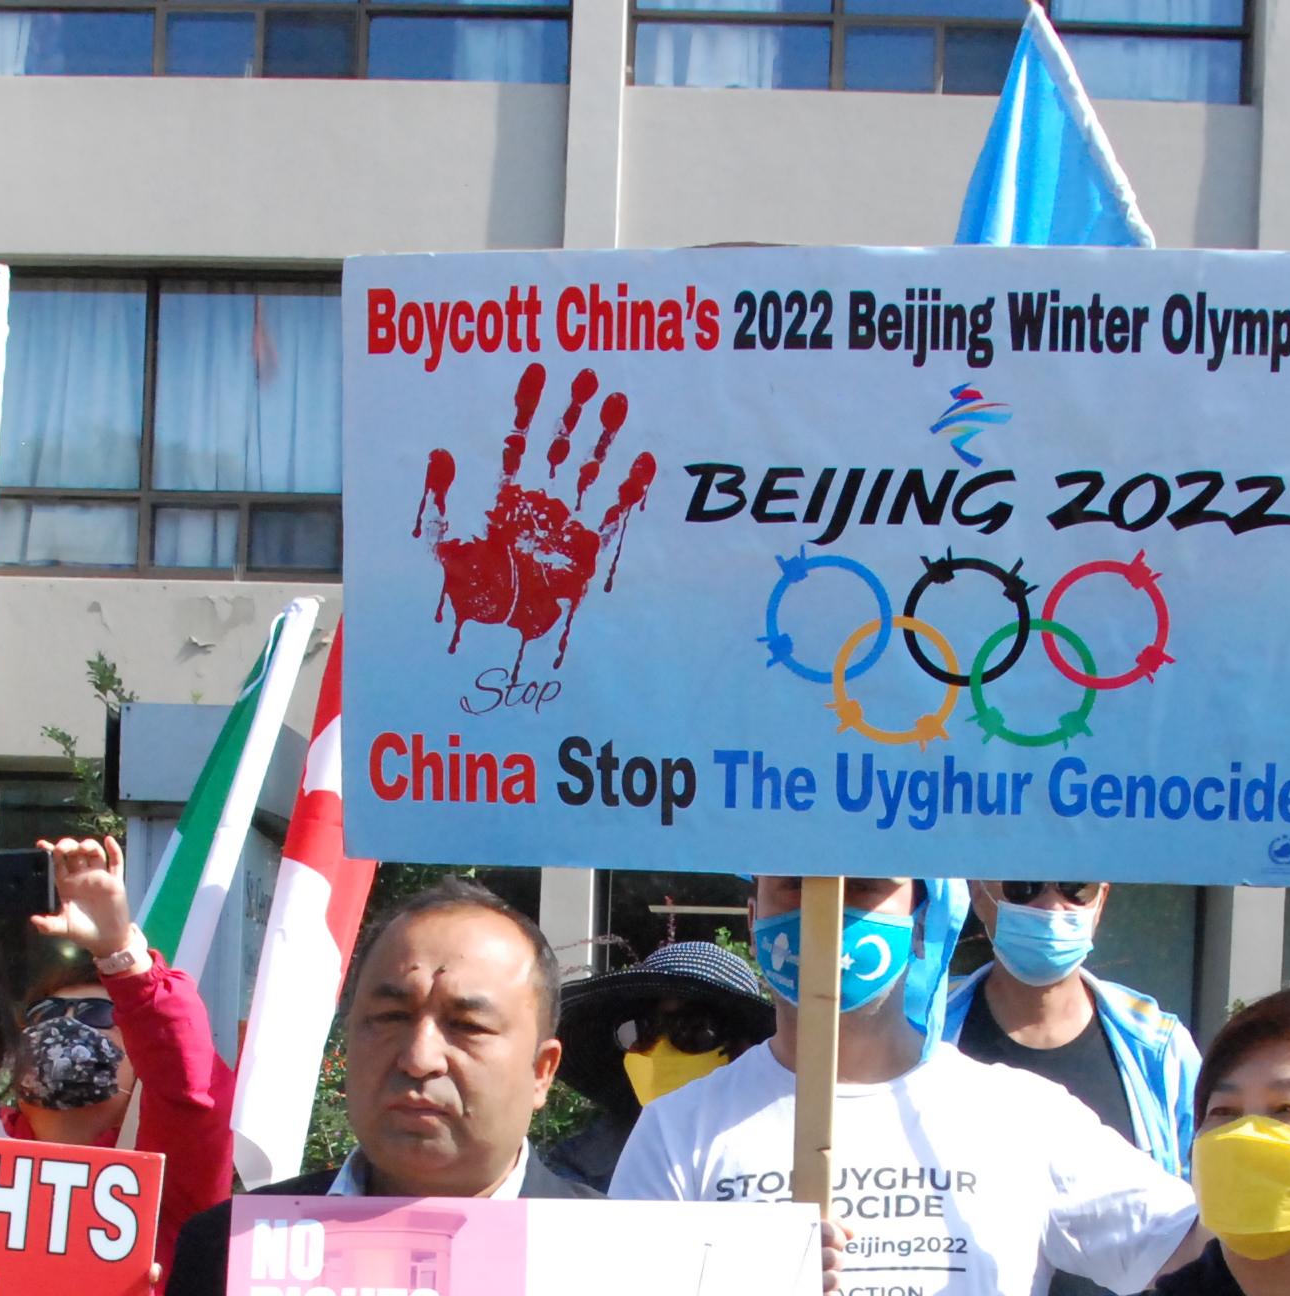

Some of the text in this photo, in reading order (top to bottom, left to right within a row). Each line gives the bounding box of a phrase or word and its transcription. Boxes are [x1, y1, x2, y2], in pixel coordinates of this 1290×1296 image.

[367, 285, 542, 372] Boycott
[556, 284, 720, 355] China's
[733, 290, 832, 350] 2022
[848, 293, 994, 369] Beijing
[1007, 293, 1148, 356] Winter
[684, 464, 1018, 545] BEIJING
[460, 667, 562, 716] Stop
[368, 733, 536, 804] China
[556, 737, 696, 825] Stop
[714, 749, 815, 812] The
[835, 754, 1035, 830] Uyghur
[716, 1170, 793, 1201] STO
[250, 1219, 325, 1280] NO
[844, 1236, 968, 1258] eijing2022
